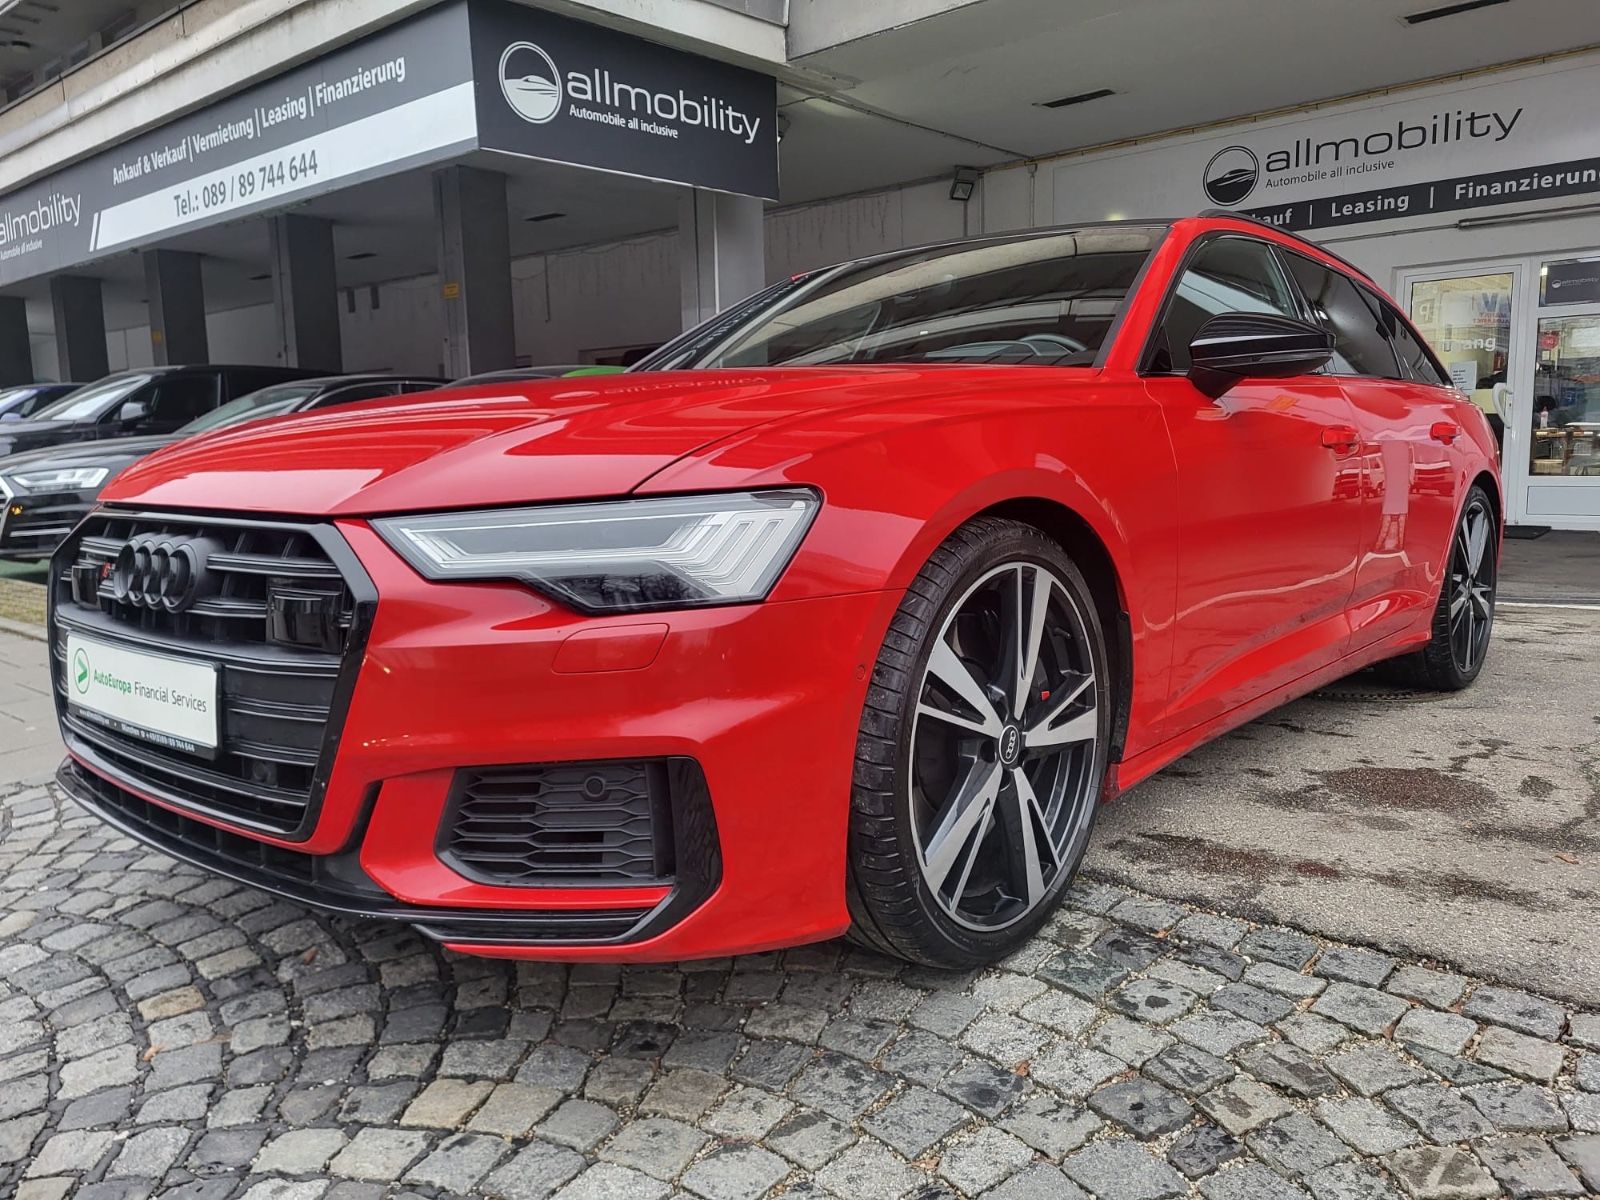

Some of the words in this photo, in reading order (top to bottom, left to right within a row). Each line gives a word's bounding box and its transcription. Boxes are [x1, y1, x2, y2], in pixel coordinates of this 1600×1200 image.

[113, 157, 142, 186] Ankauf
[144, 155, 151, 174] &
[151, 138, 187, 170] Verkauf
[193, 117, 254, 154] Vermietung
[261, 95, 307, 128] Leasing
[315, 56, 405, 107] Finanzierung
[567, 68, 760, 144] allmobility
[569, 104, 625, 128] Automobile
[627, 117, 639, 130] all
[640, 119, 679, 139] inclusive
[1265, 108, 1524, 173] allmobility
[174, 190, 199, 217] Tel.:
[203, 180, 226, 208] 089
[239, 171, 255, 197] 89
[259, 160, 285, 191] 744
[289, 149, 318, 182] 644
[1252, 208, 1293, 225] auf
[1331, 193, 1410, 218] Leasing
[1455, 168, 1600, 200] Finanzierun
[1265, 169, 1327, 189] Automobile
[1330, 166, 1343, 179] all
[1346, 159, 1395, 177] inclusive
[0, 192, 81, 246] allmobility
[94, 669, 132, 694] AutoEuropa
[134, 681, 169, 703] Financial
[172, 690, 207, 712] Services
